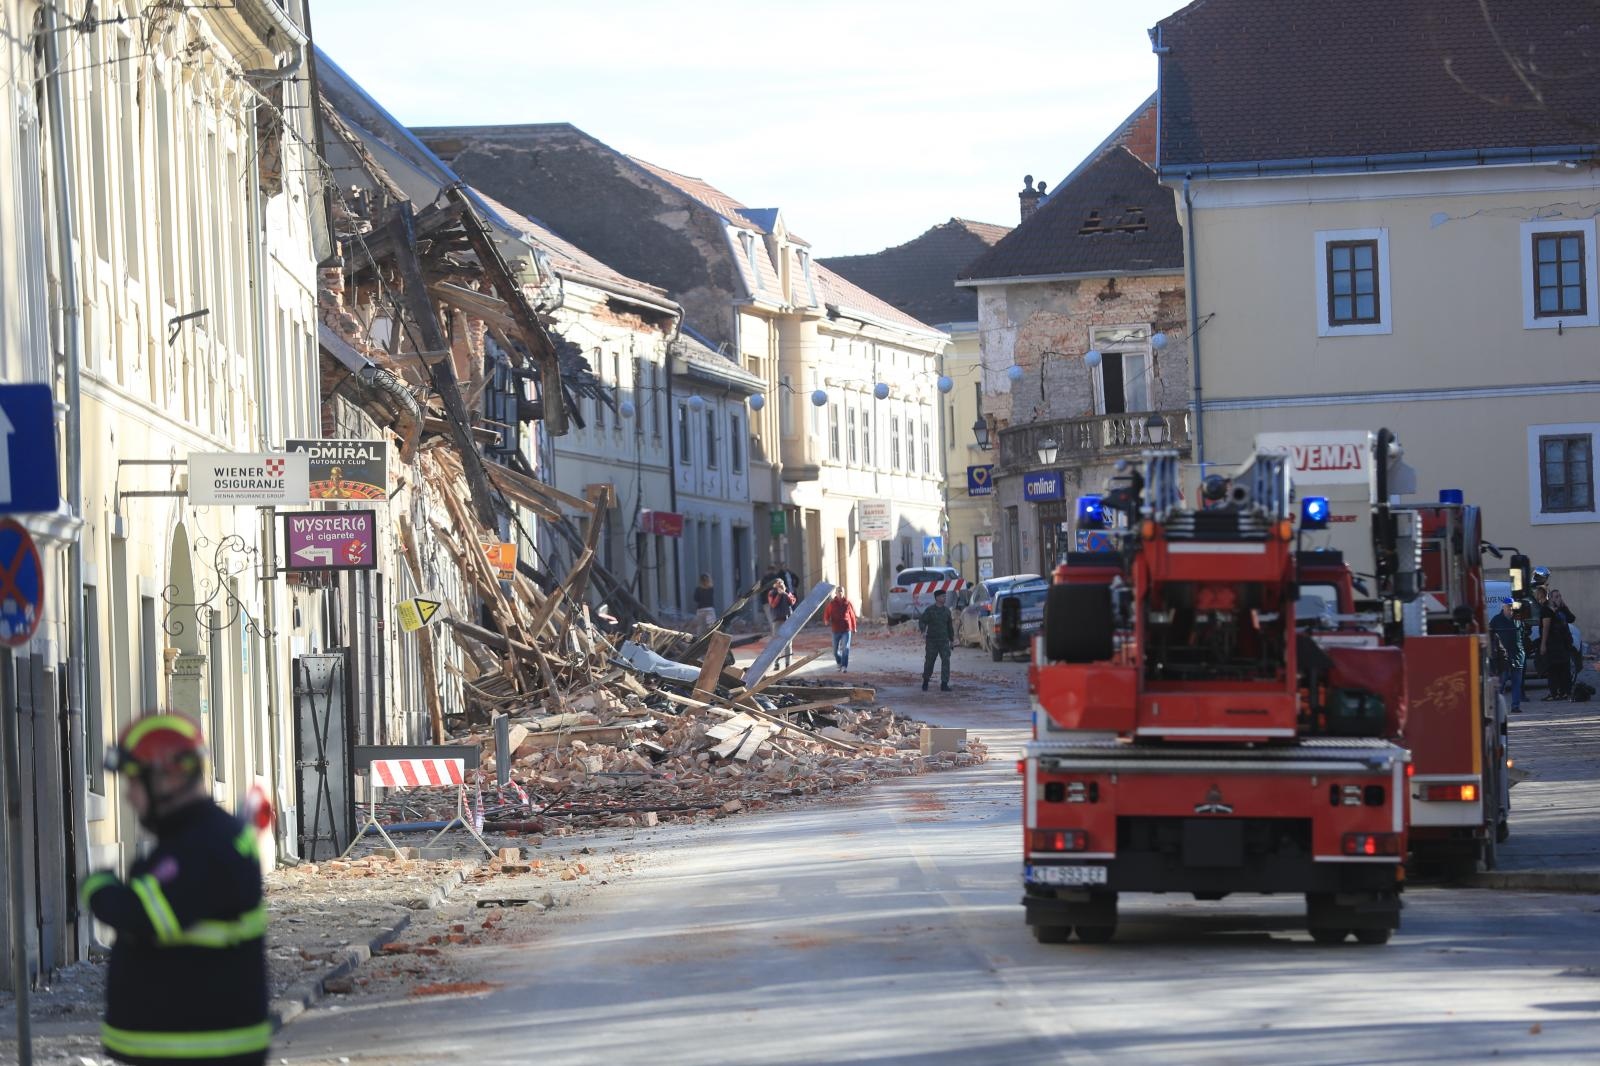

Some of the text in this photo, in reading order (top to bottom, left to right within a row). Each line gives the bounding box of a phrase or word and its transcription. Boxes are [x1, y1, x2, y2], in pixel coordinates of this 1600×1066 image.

[214, 467, 264, 477] WIENER
[214, 479, 285, 489] OSIGURANJE
[1033, 477, 1056, 495] mlinar
[293, 516, 366, 533] MYSTERIA
[305, 532, 355, 542] el cigarete
